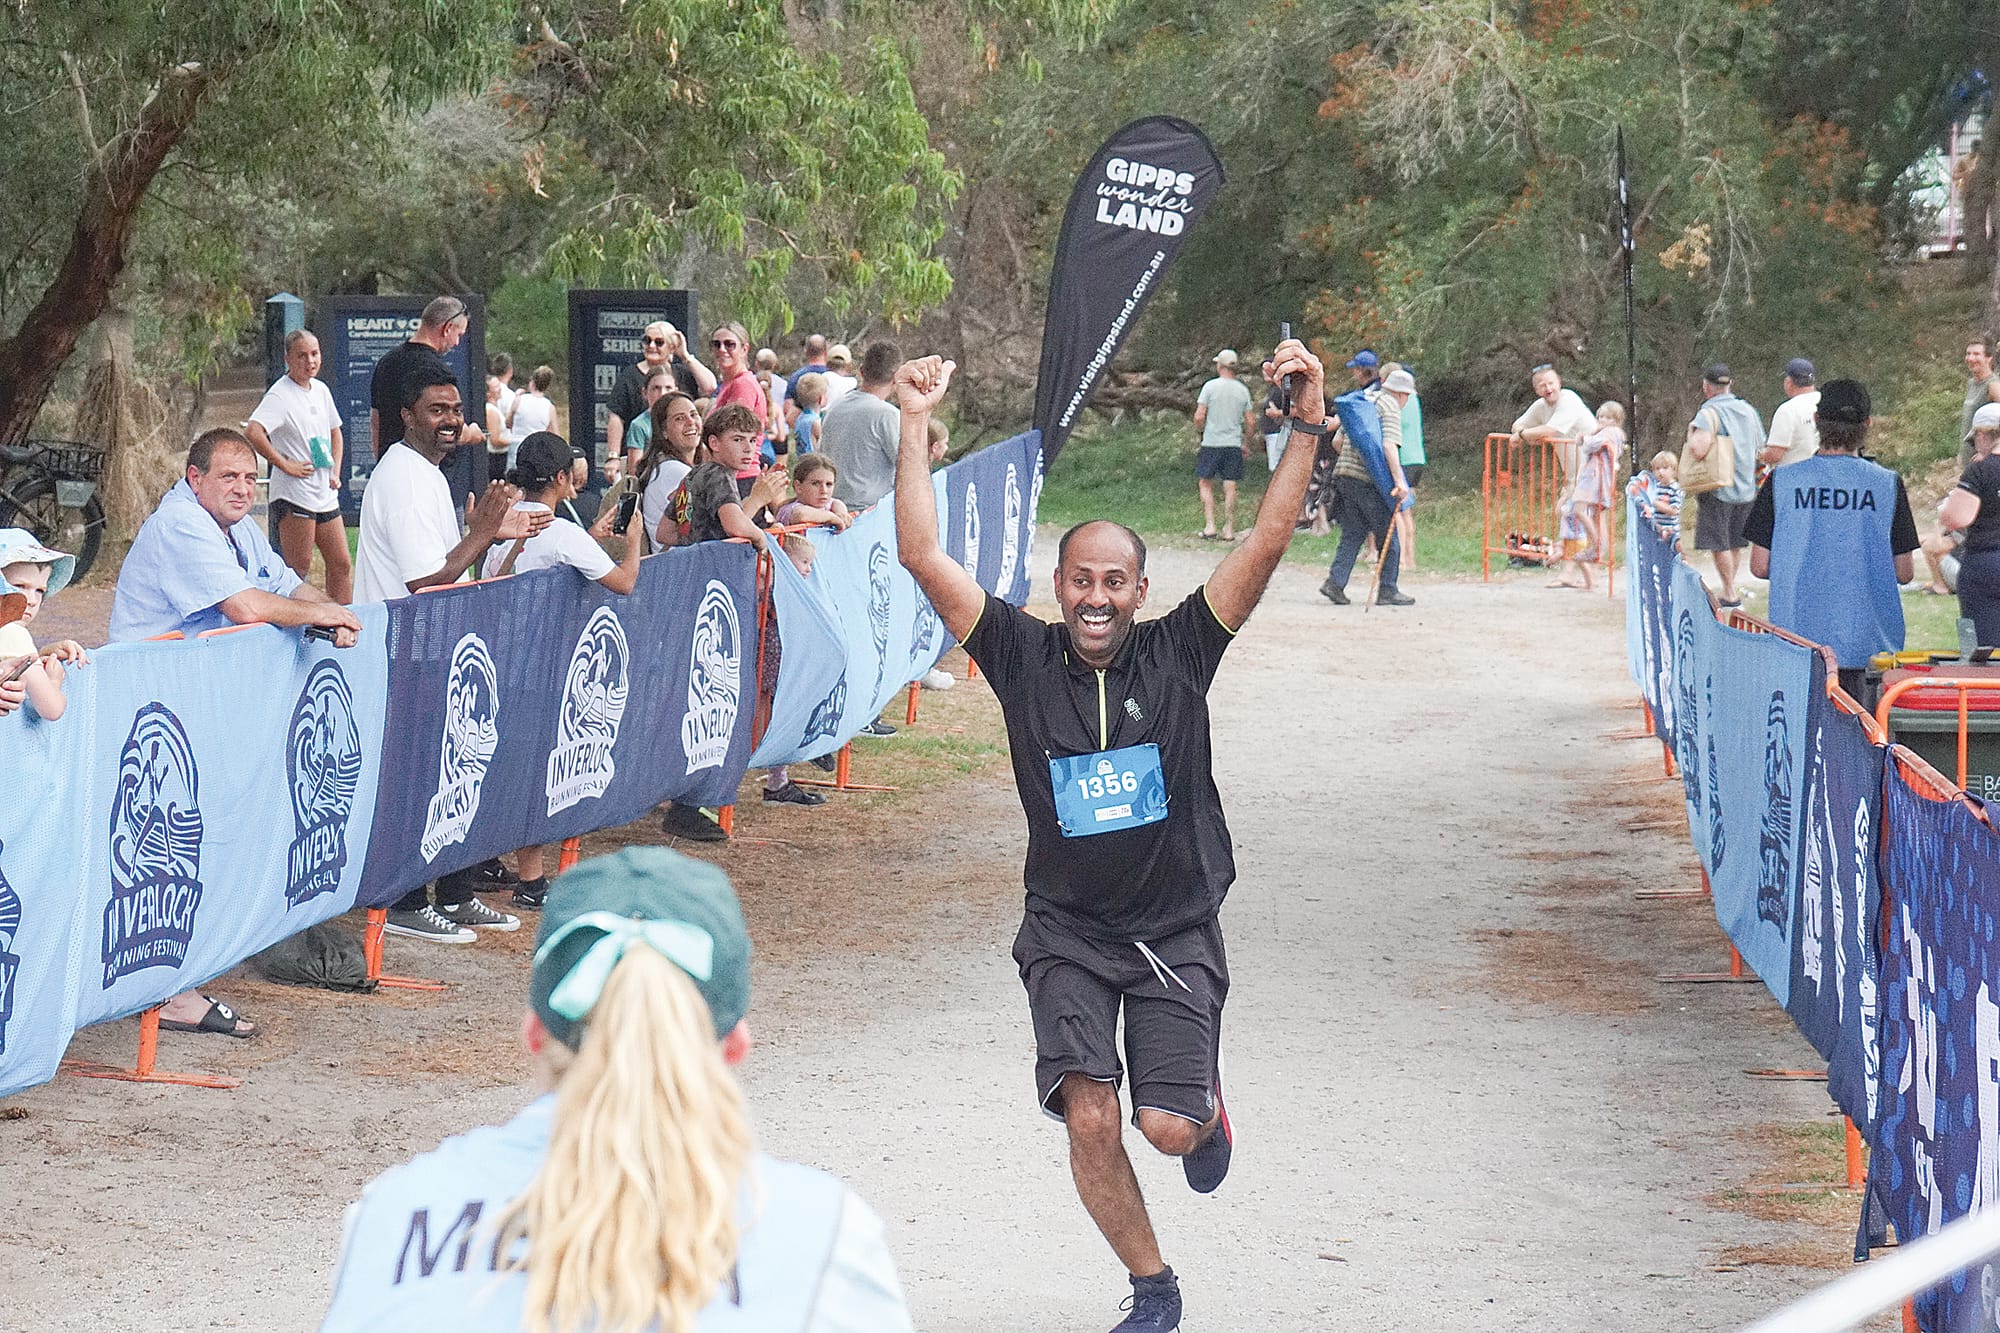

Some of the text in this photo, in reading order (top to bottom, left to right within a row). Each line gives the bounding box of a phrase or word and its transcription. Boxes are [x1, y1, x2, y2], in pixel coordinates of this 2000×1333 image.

[1106, 158, 1195, 195] GIPPS
[1096, 182, 1194, 214] wonder
[1096, 197, 1184, 236] LAND
[347, 318, 395, 330] HEART
[1058, 250, 1166, 428] www.visitgippsland.com.au
[1794, 487, 1876, 512] MEDIA
[1077, 771, 1138, 800] 1356
[153, 939, 186, 960] FESTIVAL
